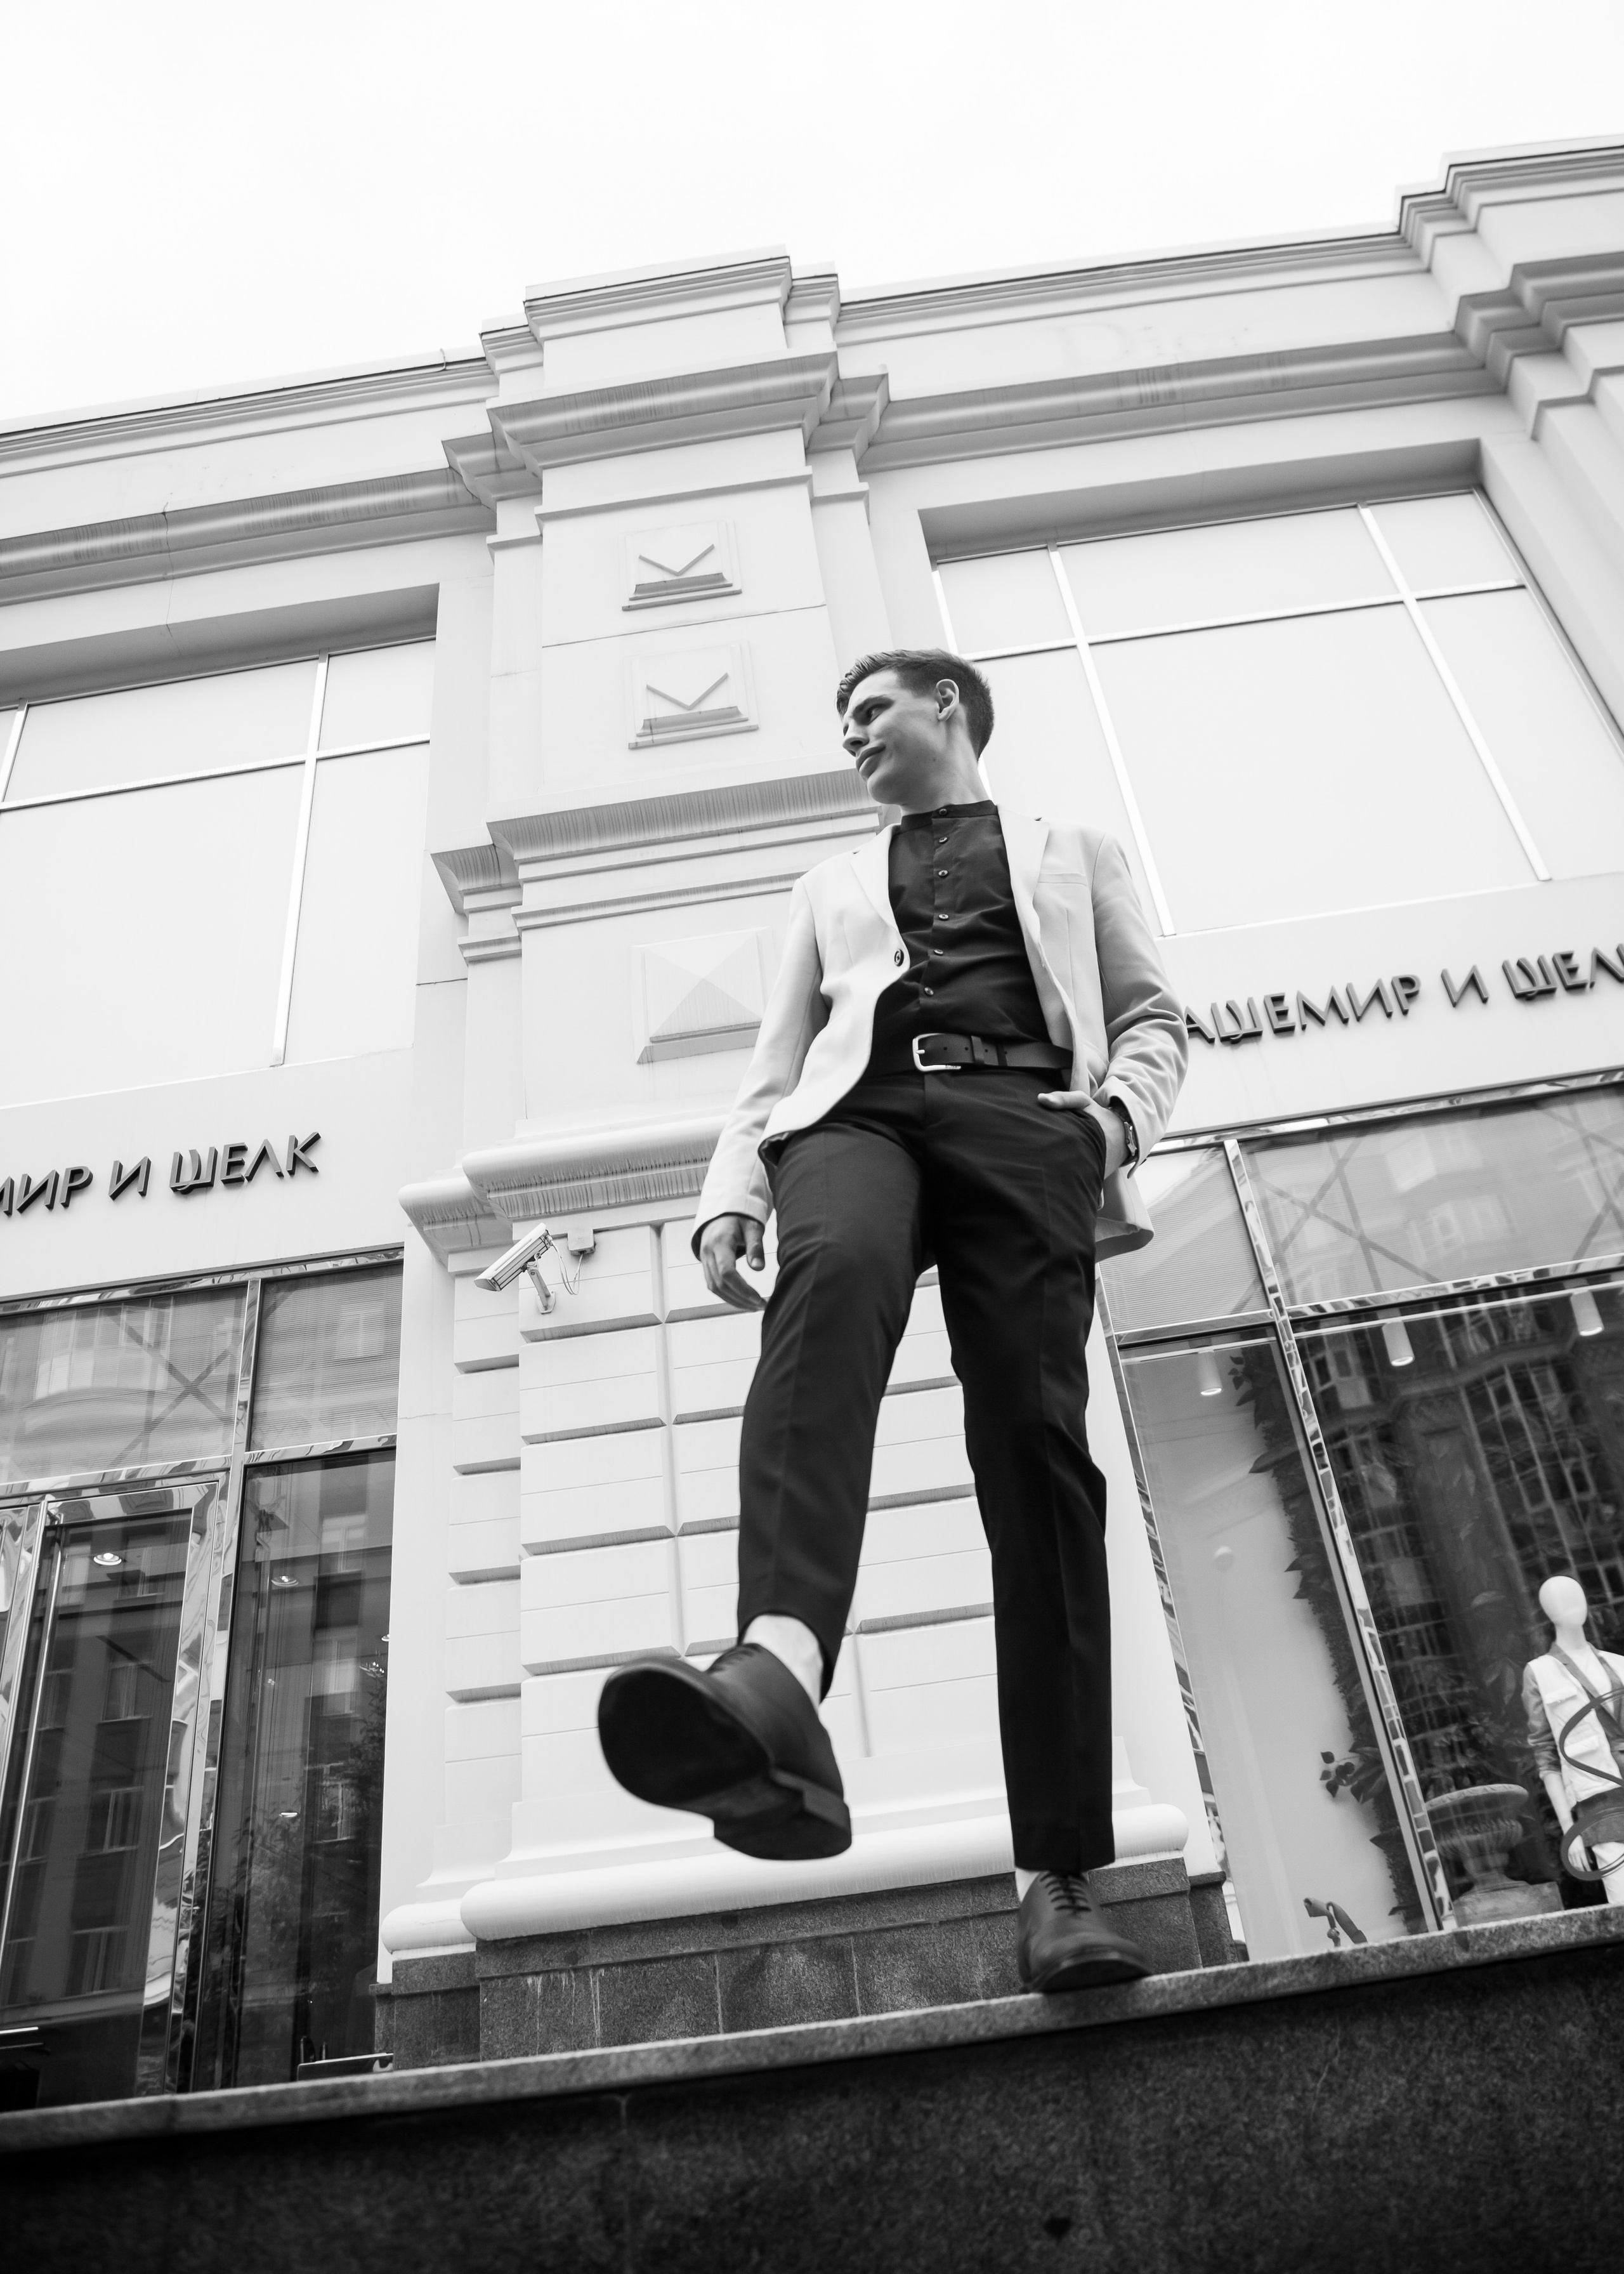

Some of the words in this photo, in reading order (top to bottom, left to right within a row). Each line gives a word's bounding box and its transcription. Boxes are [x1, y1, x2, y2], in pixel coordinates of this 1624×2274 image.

[1440, 964, 1490, 1009] И
[1501, 943, 1624, 999] ШЕЛ
[108, 1156, 152, 1200] И
[169, 1131, 322, 1195] ШЕЛК
